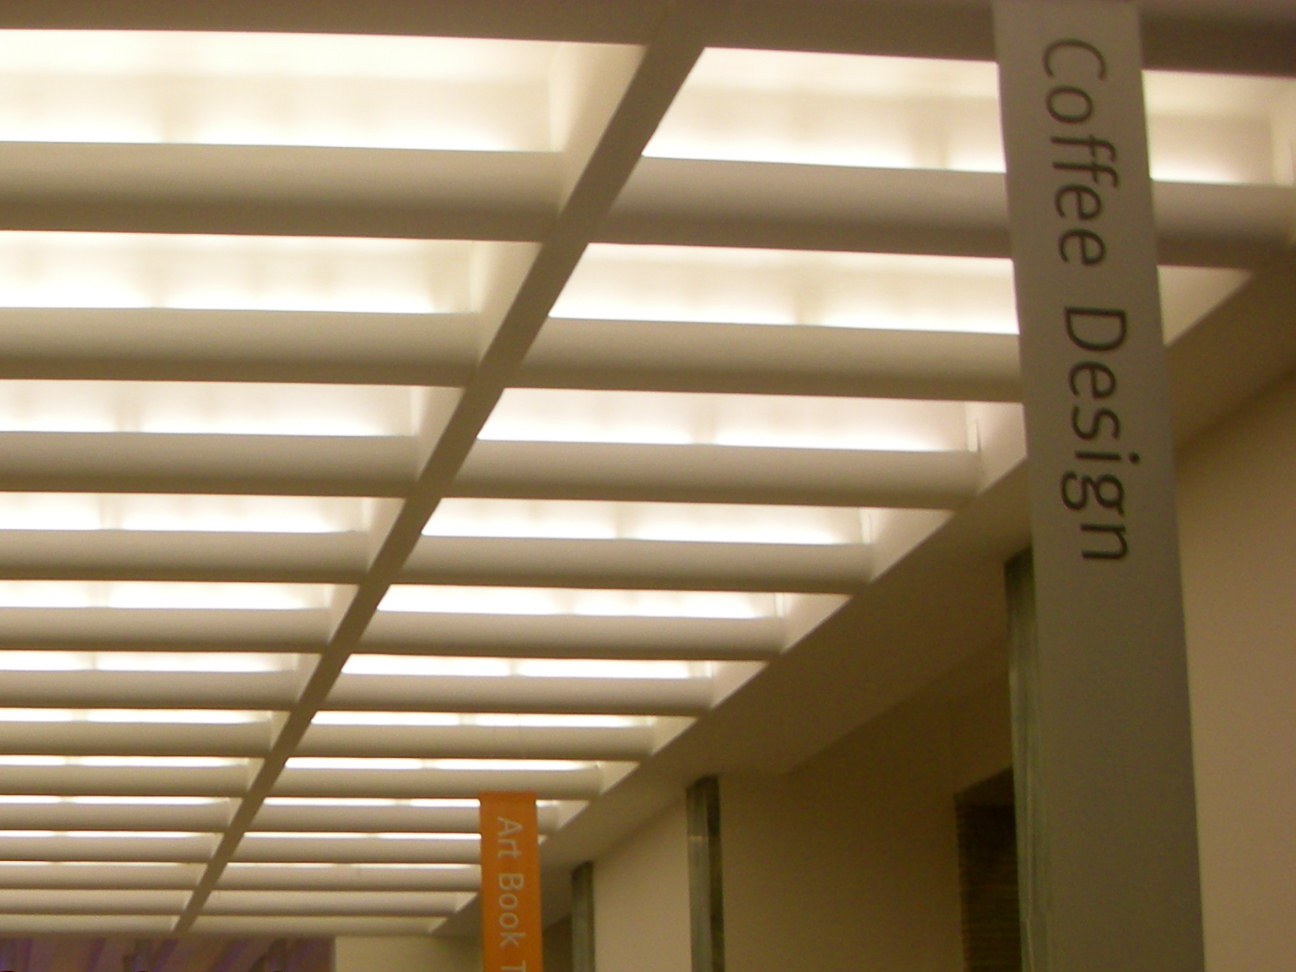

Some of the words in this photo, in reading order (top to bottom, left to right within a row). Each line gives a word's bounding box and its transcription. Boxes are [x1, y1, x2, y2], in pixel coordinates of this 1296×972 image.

[1042, 38, 1121, 268] Coffee
[1060, 306, 1141, 562] Design
[497, 815, 524, 860] Art
[497, 872, 526, 949] Book
